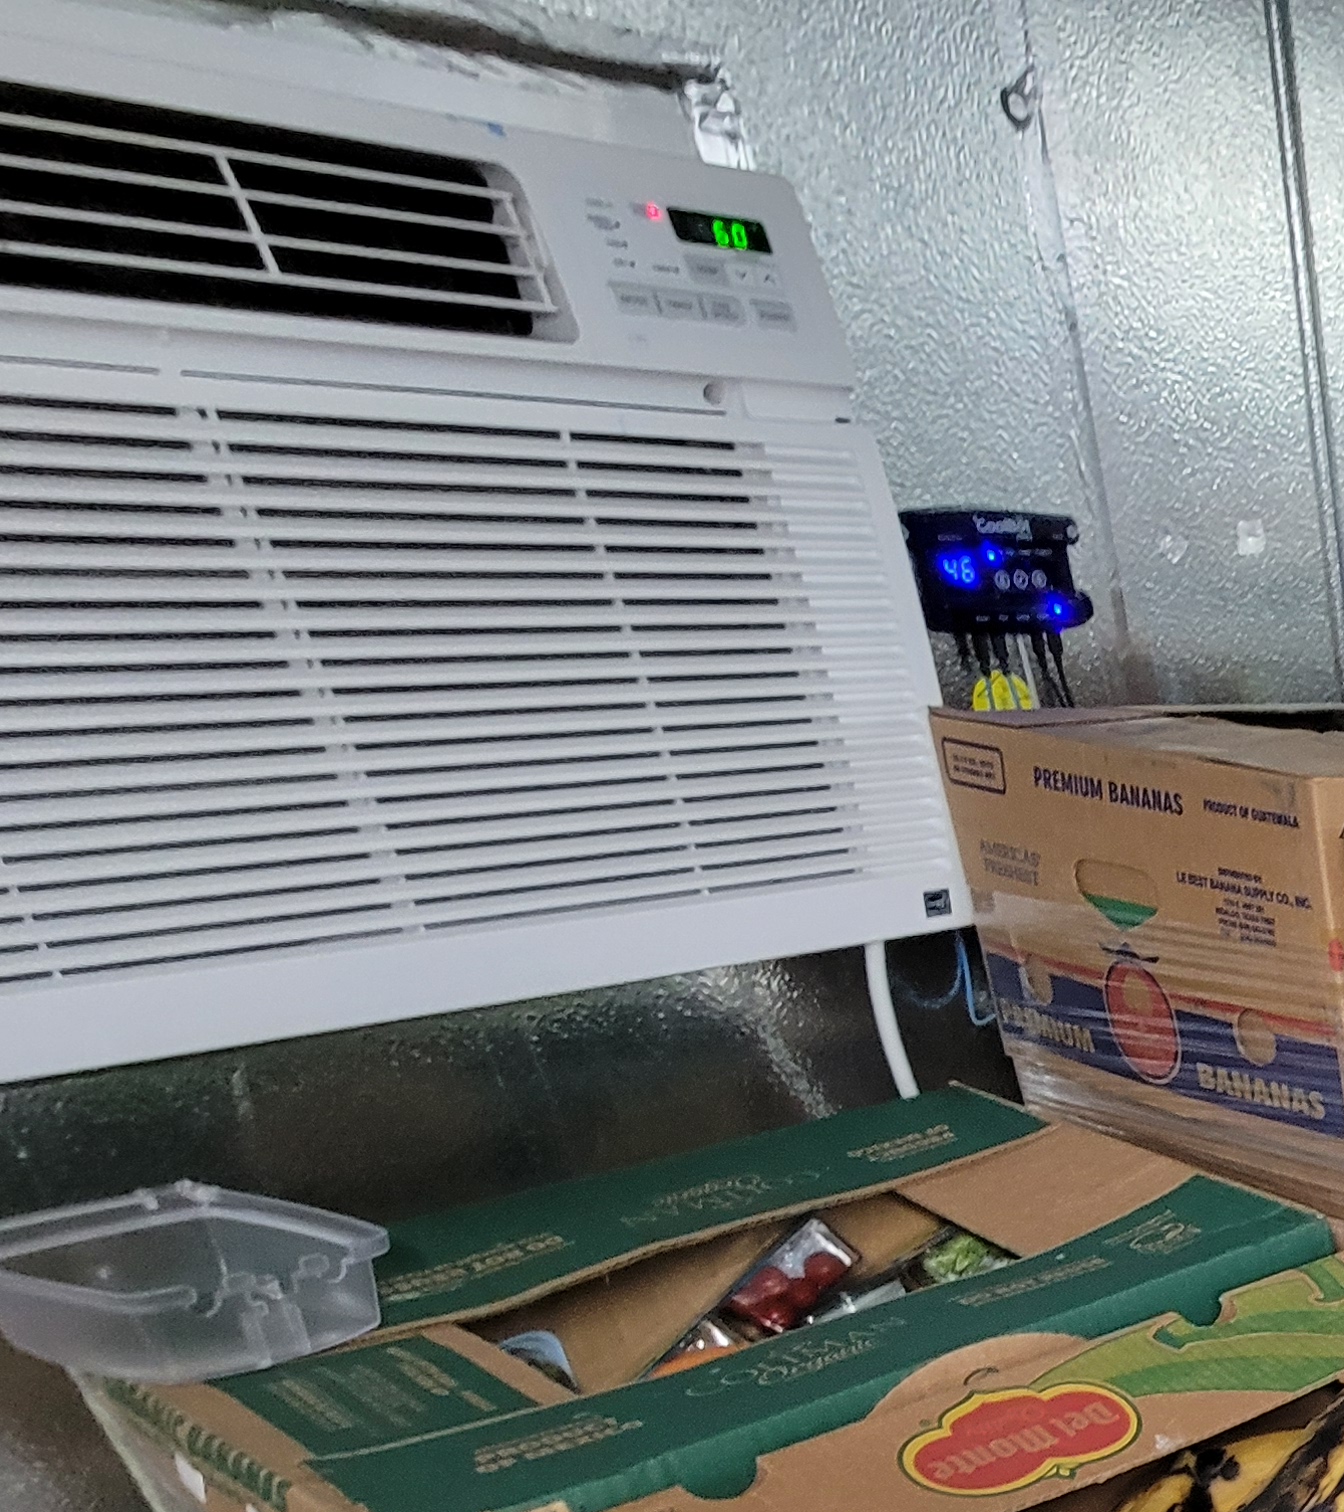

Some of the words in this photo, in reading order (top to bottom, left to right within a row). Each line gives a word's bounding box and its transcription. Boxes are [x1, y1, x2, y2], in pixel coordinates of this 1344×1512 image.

[710, 217, 749, 250] 60
[942, 555, 976, 584] 46
[1032, 765, 1103, 802] PREMIUM
[1108, 780, 1184, 816] BANANAS
[1196, 1062, 1326, 1121] BANANAS
[1051, 1400, 1120, 1437] Del
[928, 1424, 1059, 1480] Monte
